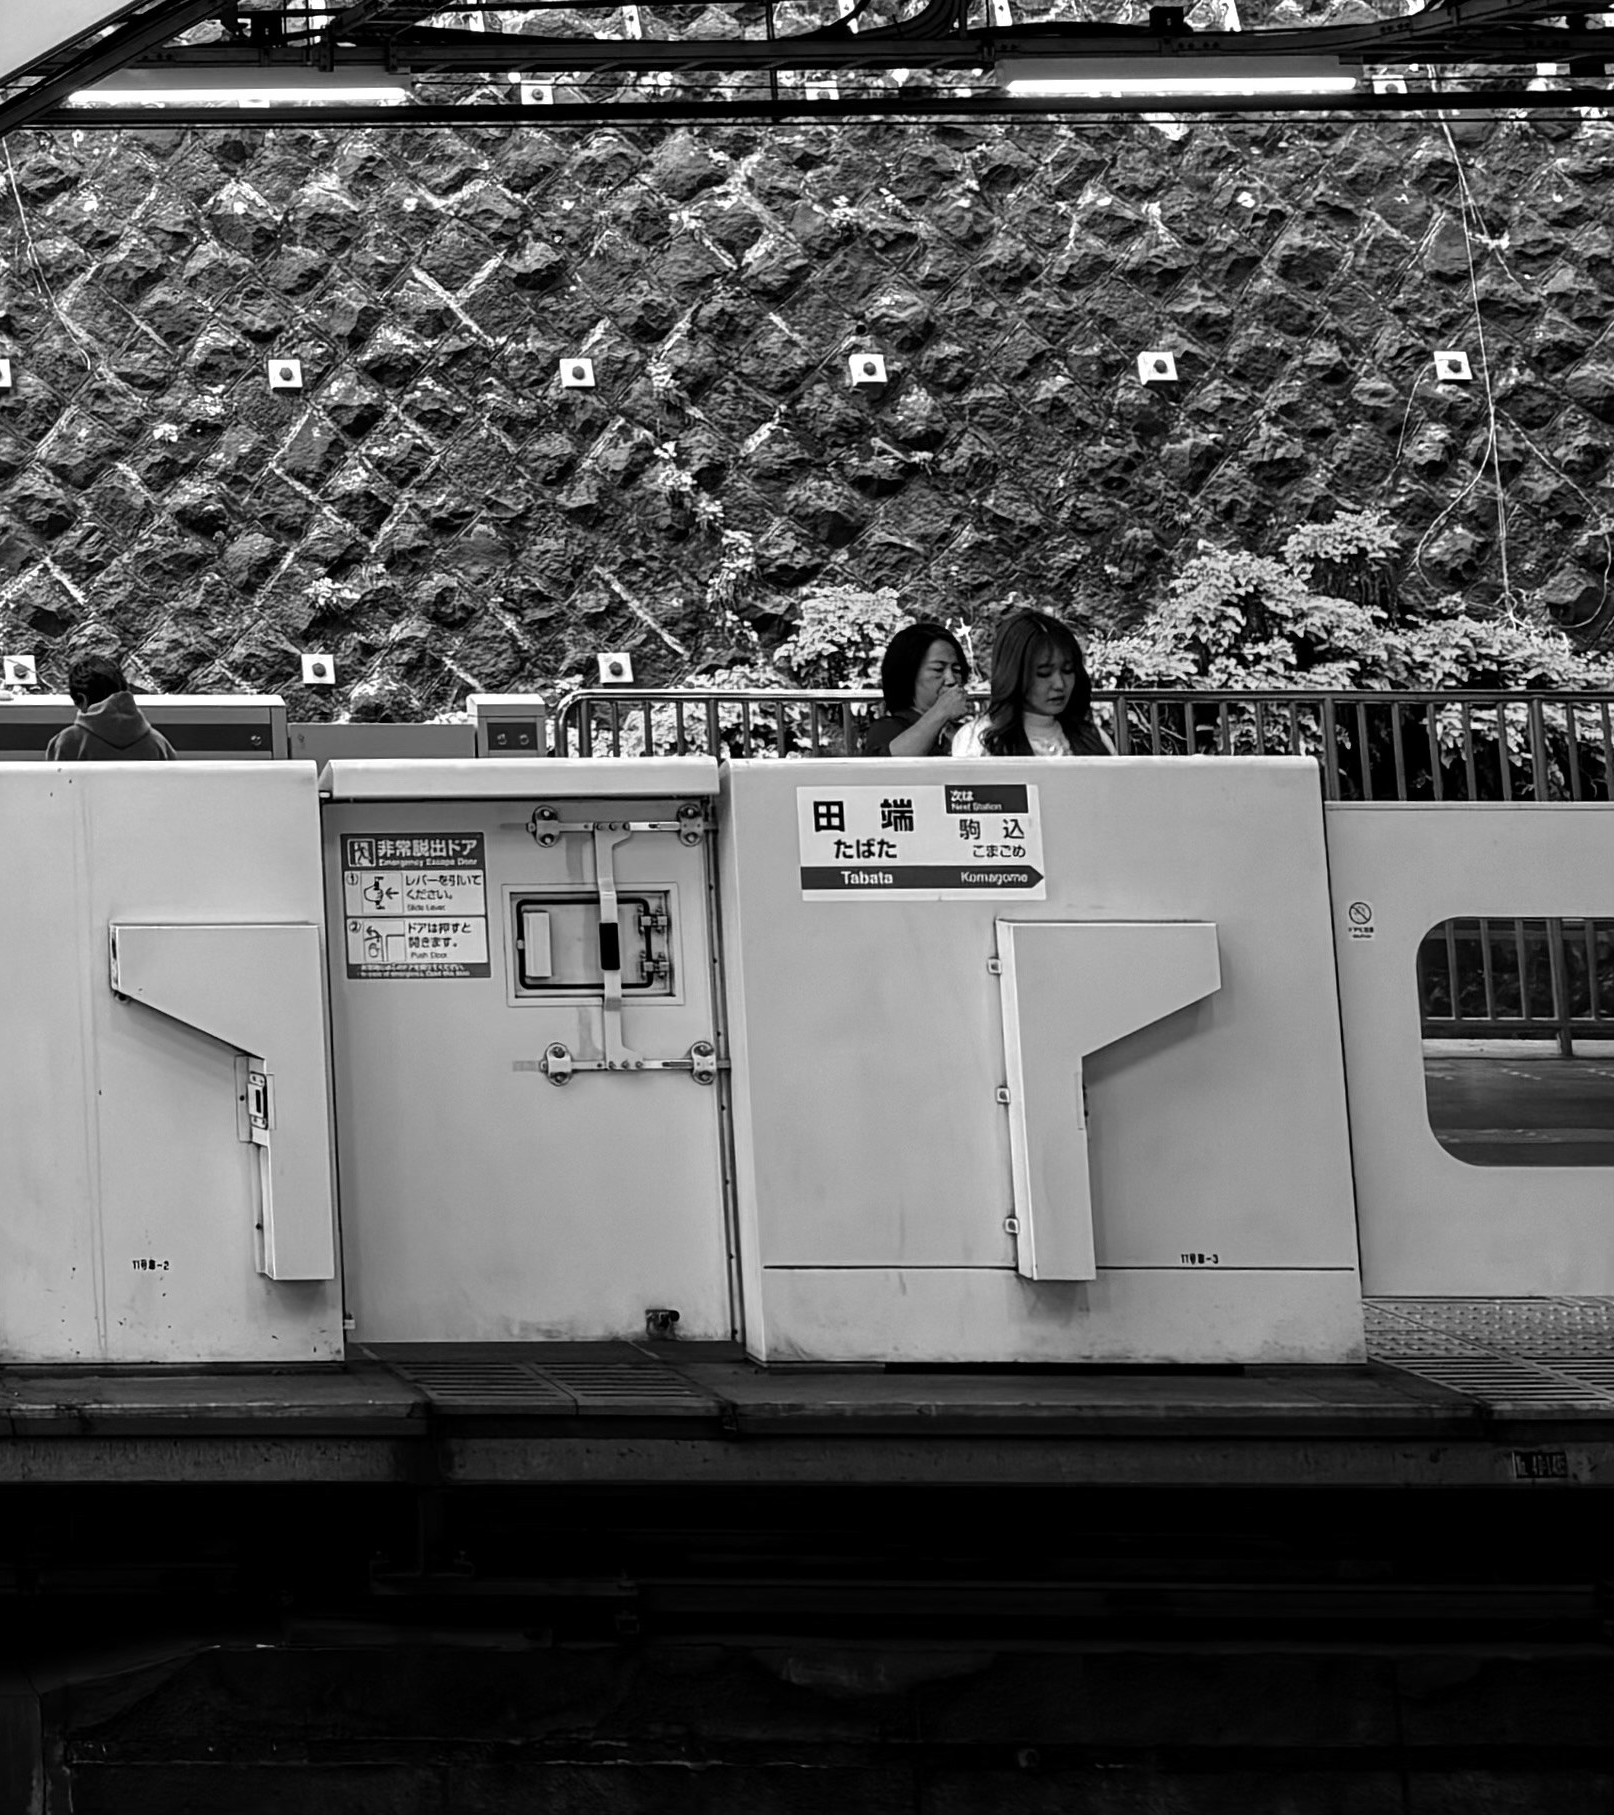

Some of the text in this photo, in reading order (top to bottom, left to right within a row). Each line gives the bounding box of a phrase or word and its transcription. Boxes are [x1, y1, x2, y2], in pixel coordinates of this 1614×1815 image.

[950, 790, 974, 802] 次は
[951, 802, 1002, 811] Next Station
[813, 798, 914, 832] 田端
[958, 818, 1026, 841] 駒込
[377, 839, 477, 858] 非常脱出ドア
[833, 839, 898, 860] たばた
[972, 844, 1027, 859] こまごめ
[378, 857, 478, 868] Emergency Escape Door
[405, 874, 482, 887] レバーを引いて
[840, 870, 894, 886] Tabata
[960, 871, 1028, 885] Komagome
[406, 889, 453, 901] ください。
[407, 922, 471, 934] ドアは押すと
[408, 936, 458, 949] 開きます。
